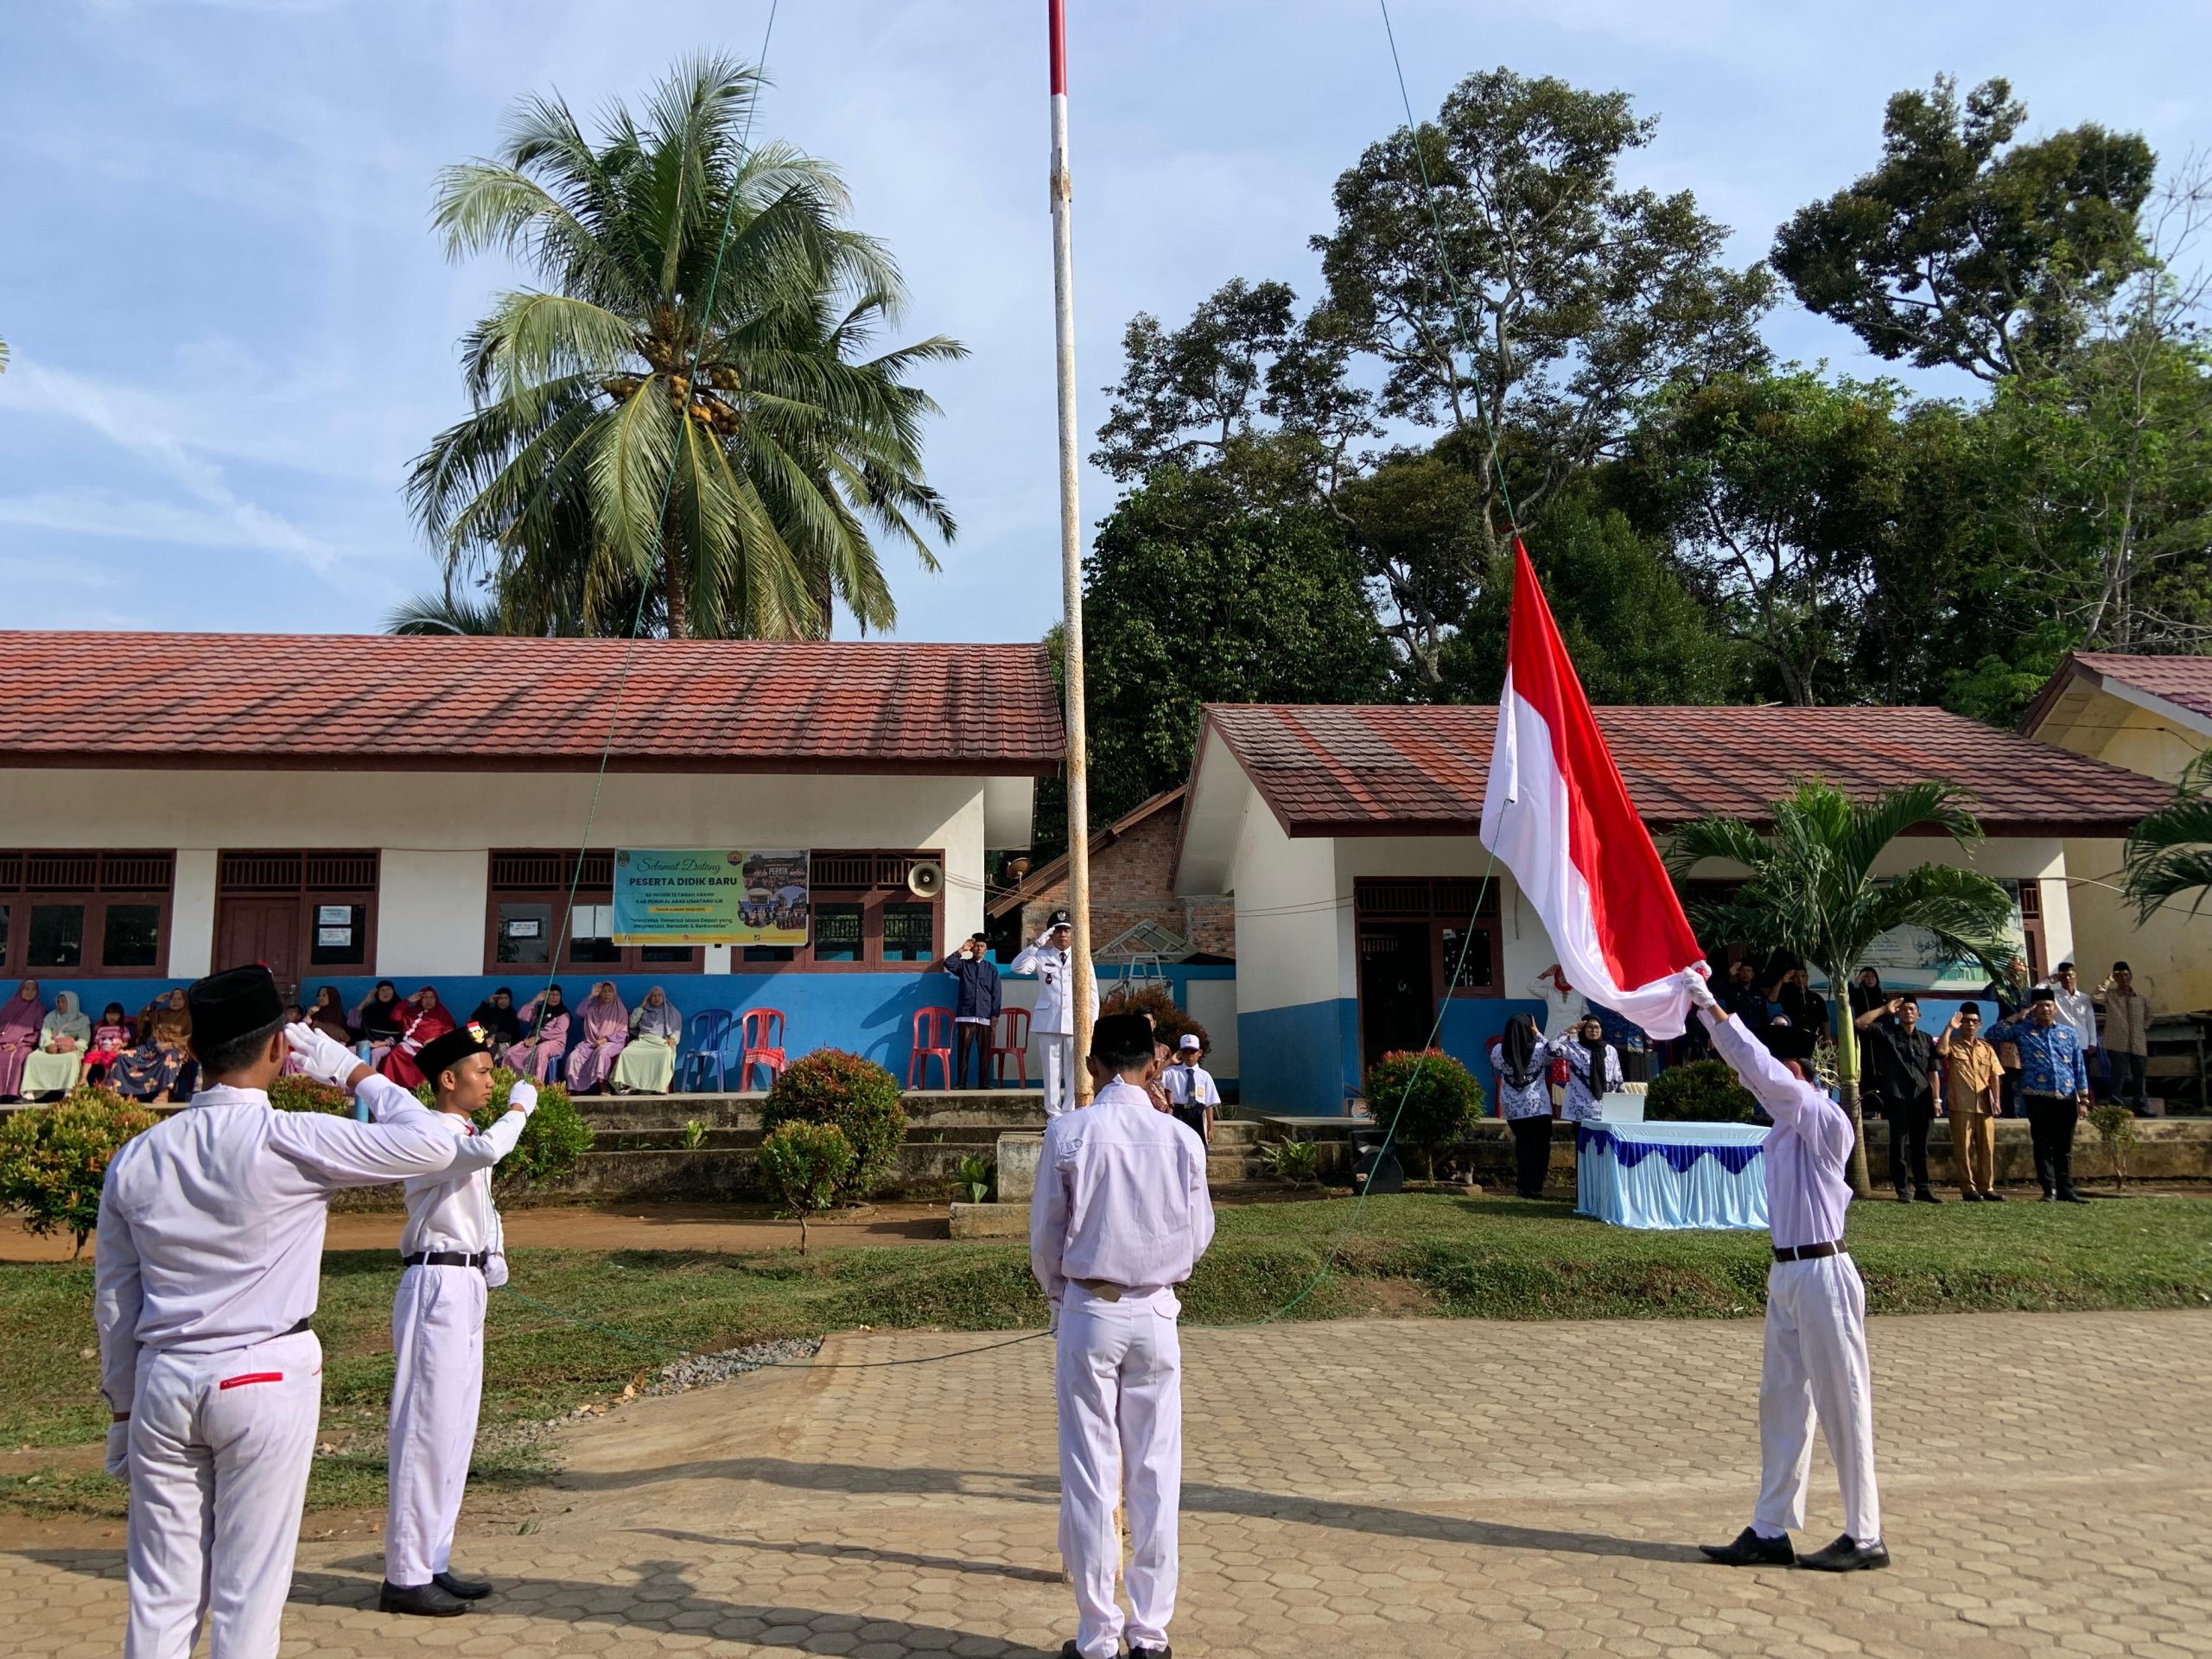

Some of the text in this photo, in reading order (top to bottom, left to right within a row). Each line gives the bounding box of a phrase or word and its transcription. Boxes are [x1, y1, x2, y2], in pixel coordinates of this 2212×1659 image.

[636, 858, 721, 875] Selamat Datang
[629, 877, 737, 886] PESERTA DIDIK BARU
